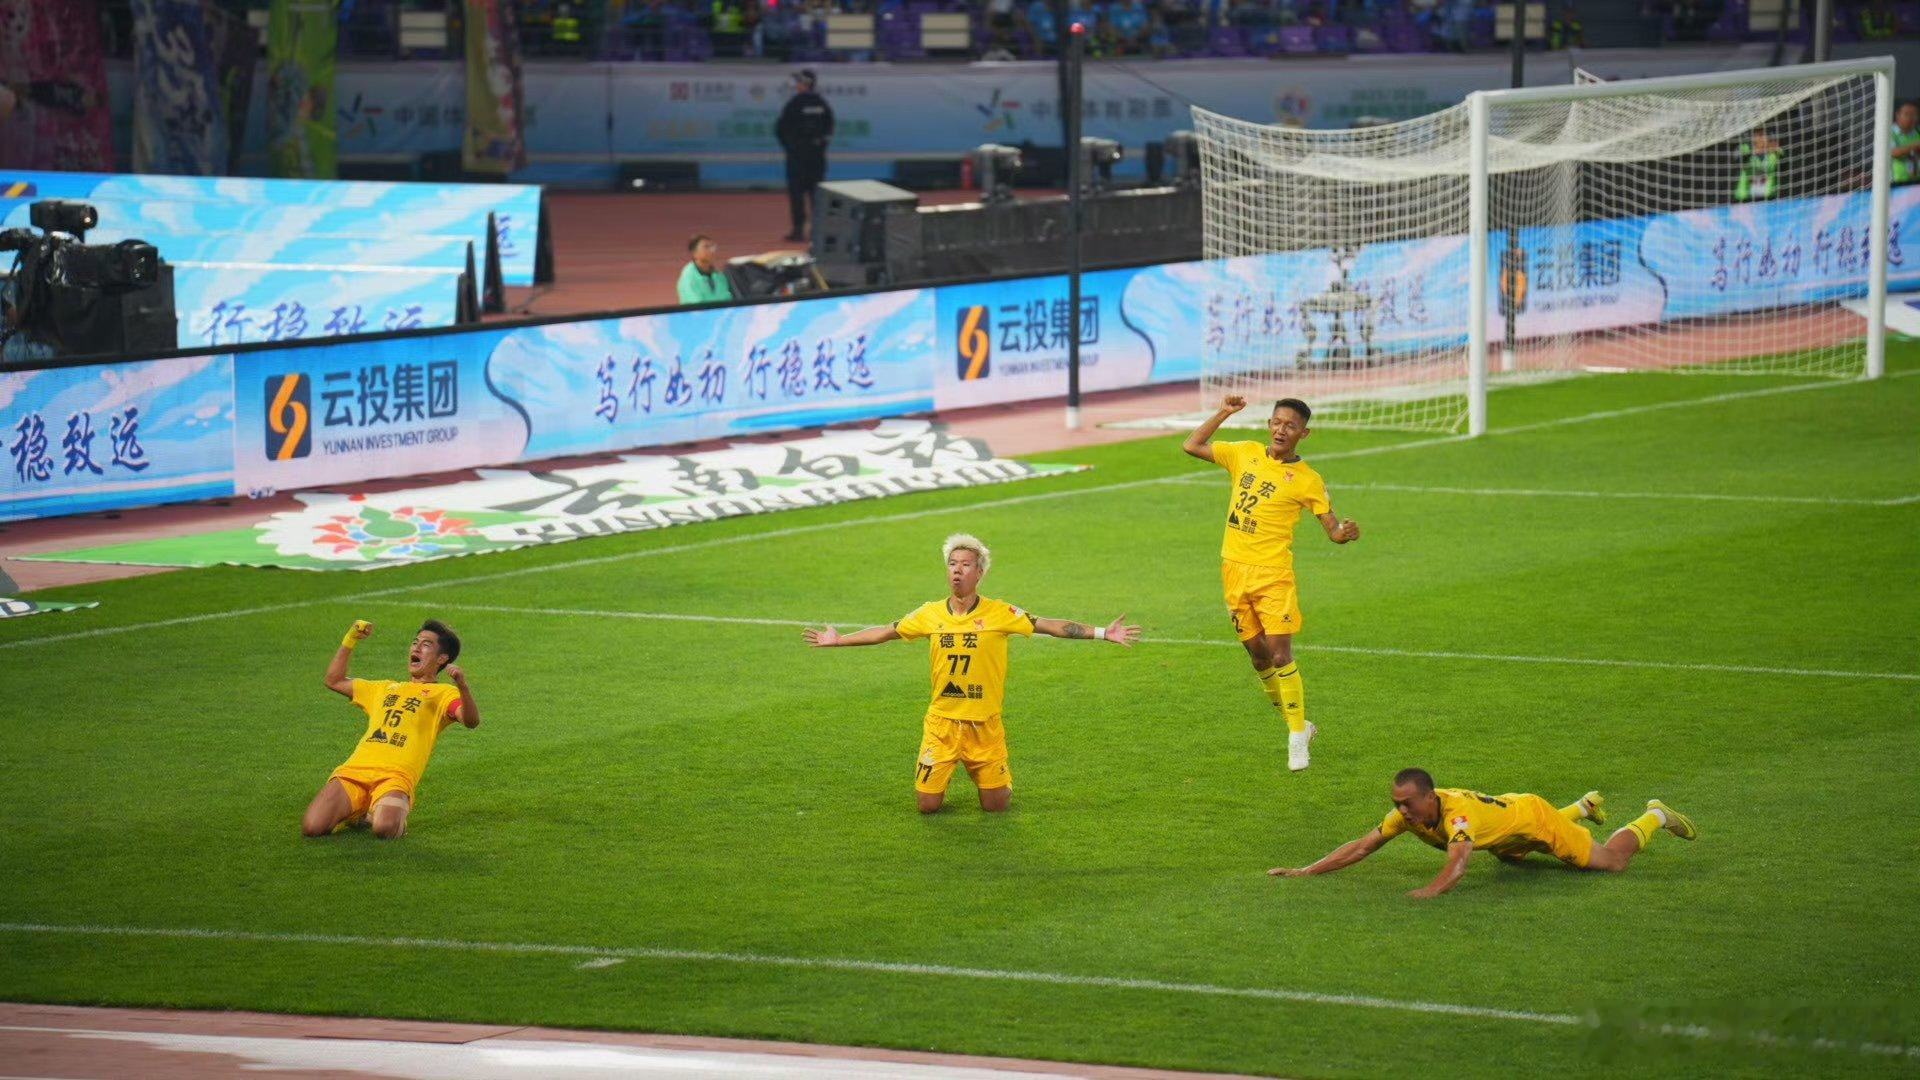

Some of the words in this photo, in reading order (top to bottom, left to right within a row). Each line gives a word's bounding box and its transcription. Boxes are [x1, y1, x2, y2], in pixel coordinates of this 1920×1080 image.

[998, 294, 1100, 352] 云投集团
[745, 334, 874, 400] 行稳致远
[320, 359, 459, 427] 云投集团
[0, 407, 150, 484] 稳致远
[322, 437, 364, 456] YUNNAN
[365, 430, 425, 451] INVESTMENT
[426, 425, 460, 445] GROUP
[1239, 471, 1277, 499] 德宏
[1235, 490, 1259, 515] 32
[939, 632, 978, 649] 德宏
[947, 654, 971, 676] 77
[383, 693, 422, 714] 德宏
[383, 708, 403, 728] 15
[915, 761, 934, 785] 77
